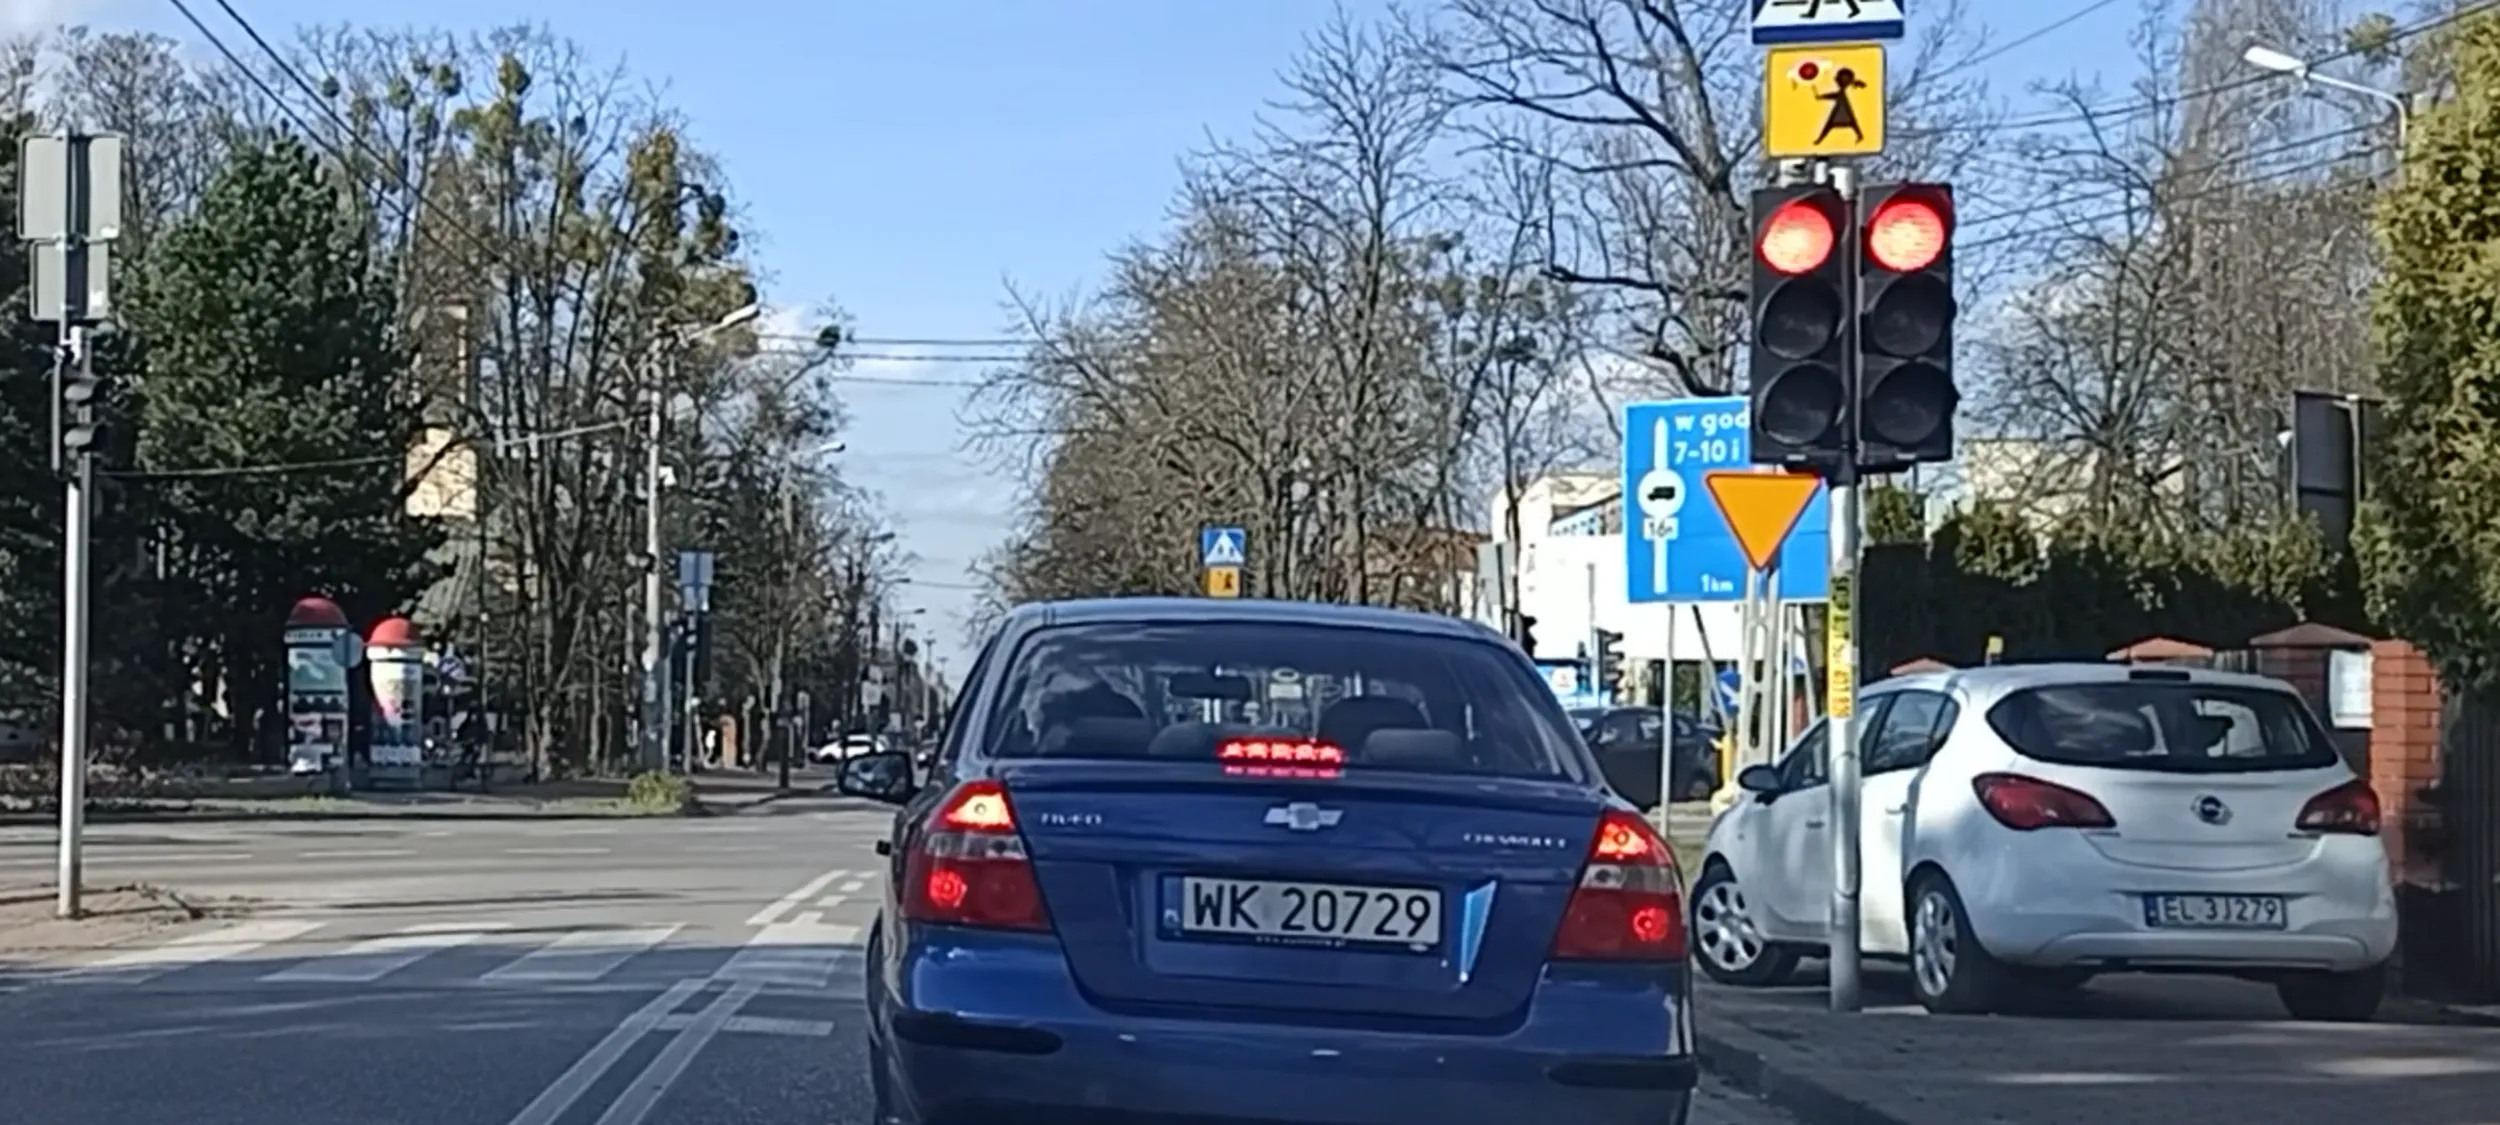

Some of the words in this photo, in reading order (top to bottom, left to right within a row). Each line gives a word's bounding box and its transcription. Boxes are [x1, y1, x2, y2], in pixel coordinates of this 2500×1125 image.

[1674, 414, 1696, 432] w
[1673, 439, 1727, 464] 7-10
[1731, 437, 1740, 463] i
[1192, 881, 1261, 930] WK
[1280, 886, 1432, 938] 20729
[2164, 896, 2195, 921] EL
[2204, 896, 2279, 923] 3J279
